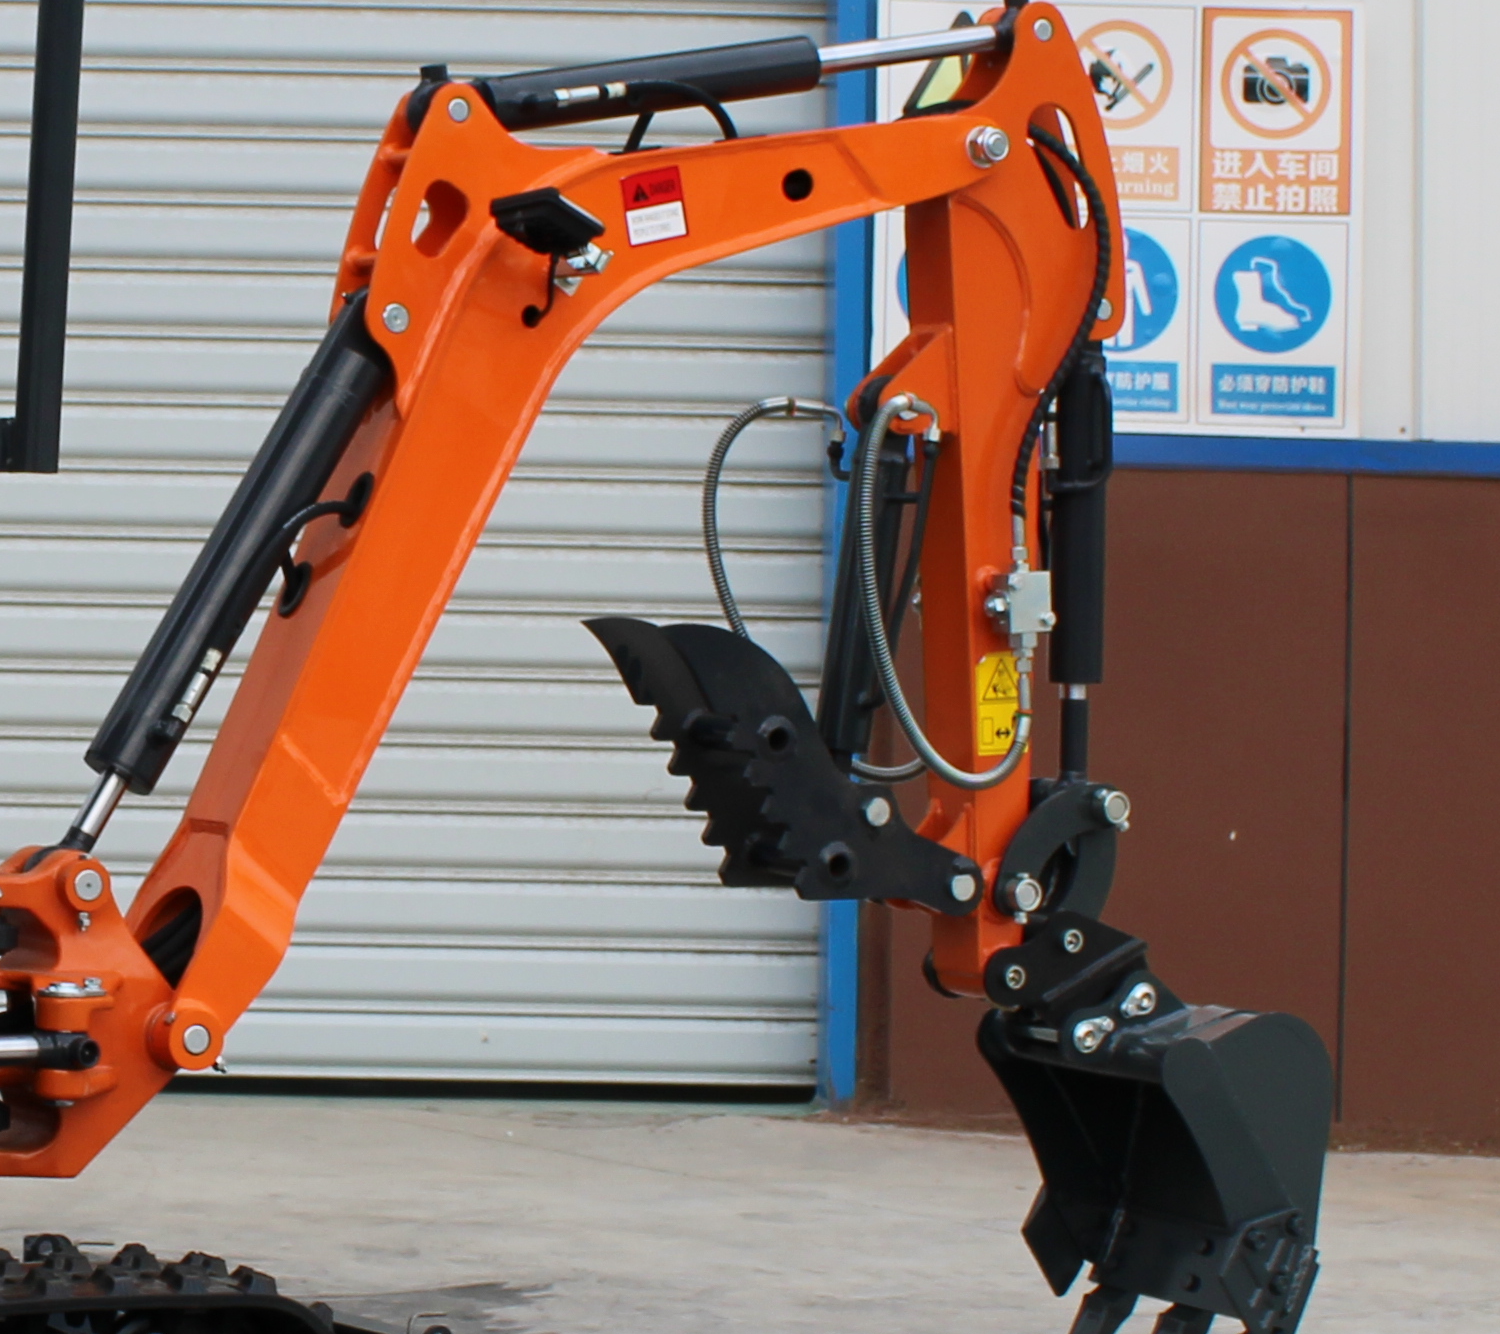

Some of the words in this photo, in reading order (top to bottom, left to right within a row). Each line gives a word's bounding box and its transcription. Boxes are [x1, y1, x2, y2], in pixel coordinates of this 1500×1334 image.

[1212, 151, 1339, 181] 进入车间
[1212, 183, 1339, 213] 禁止拍照
